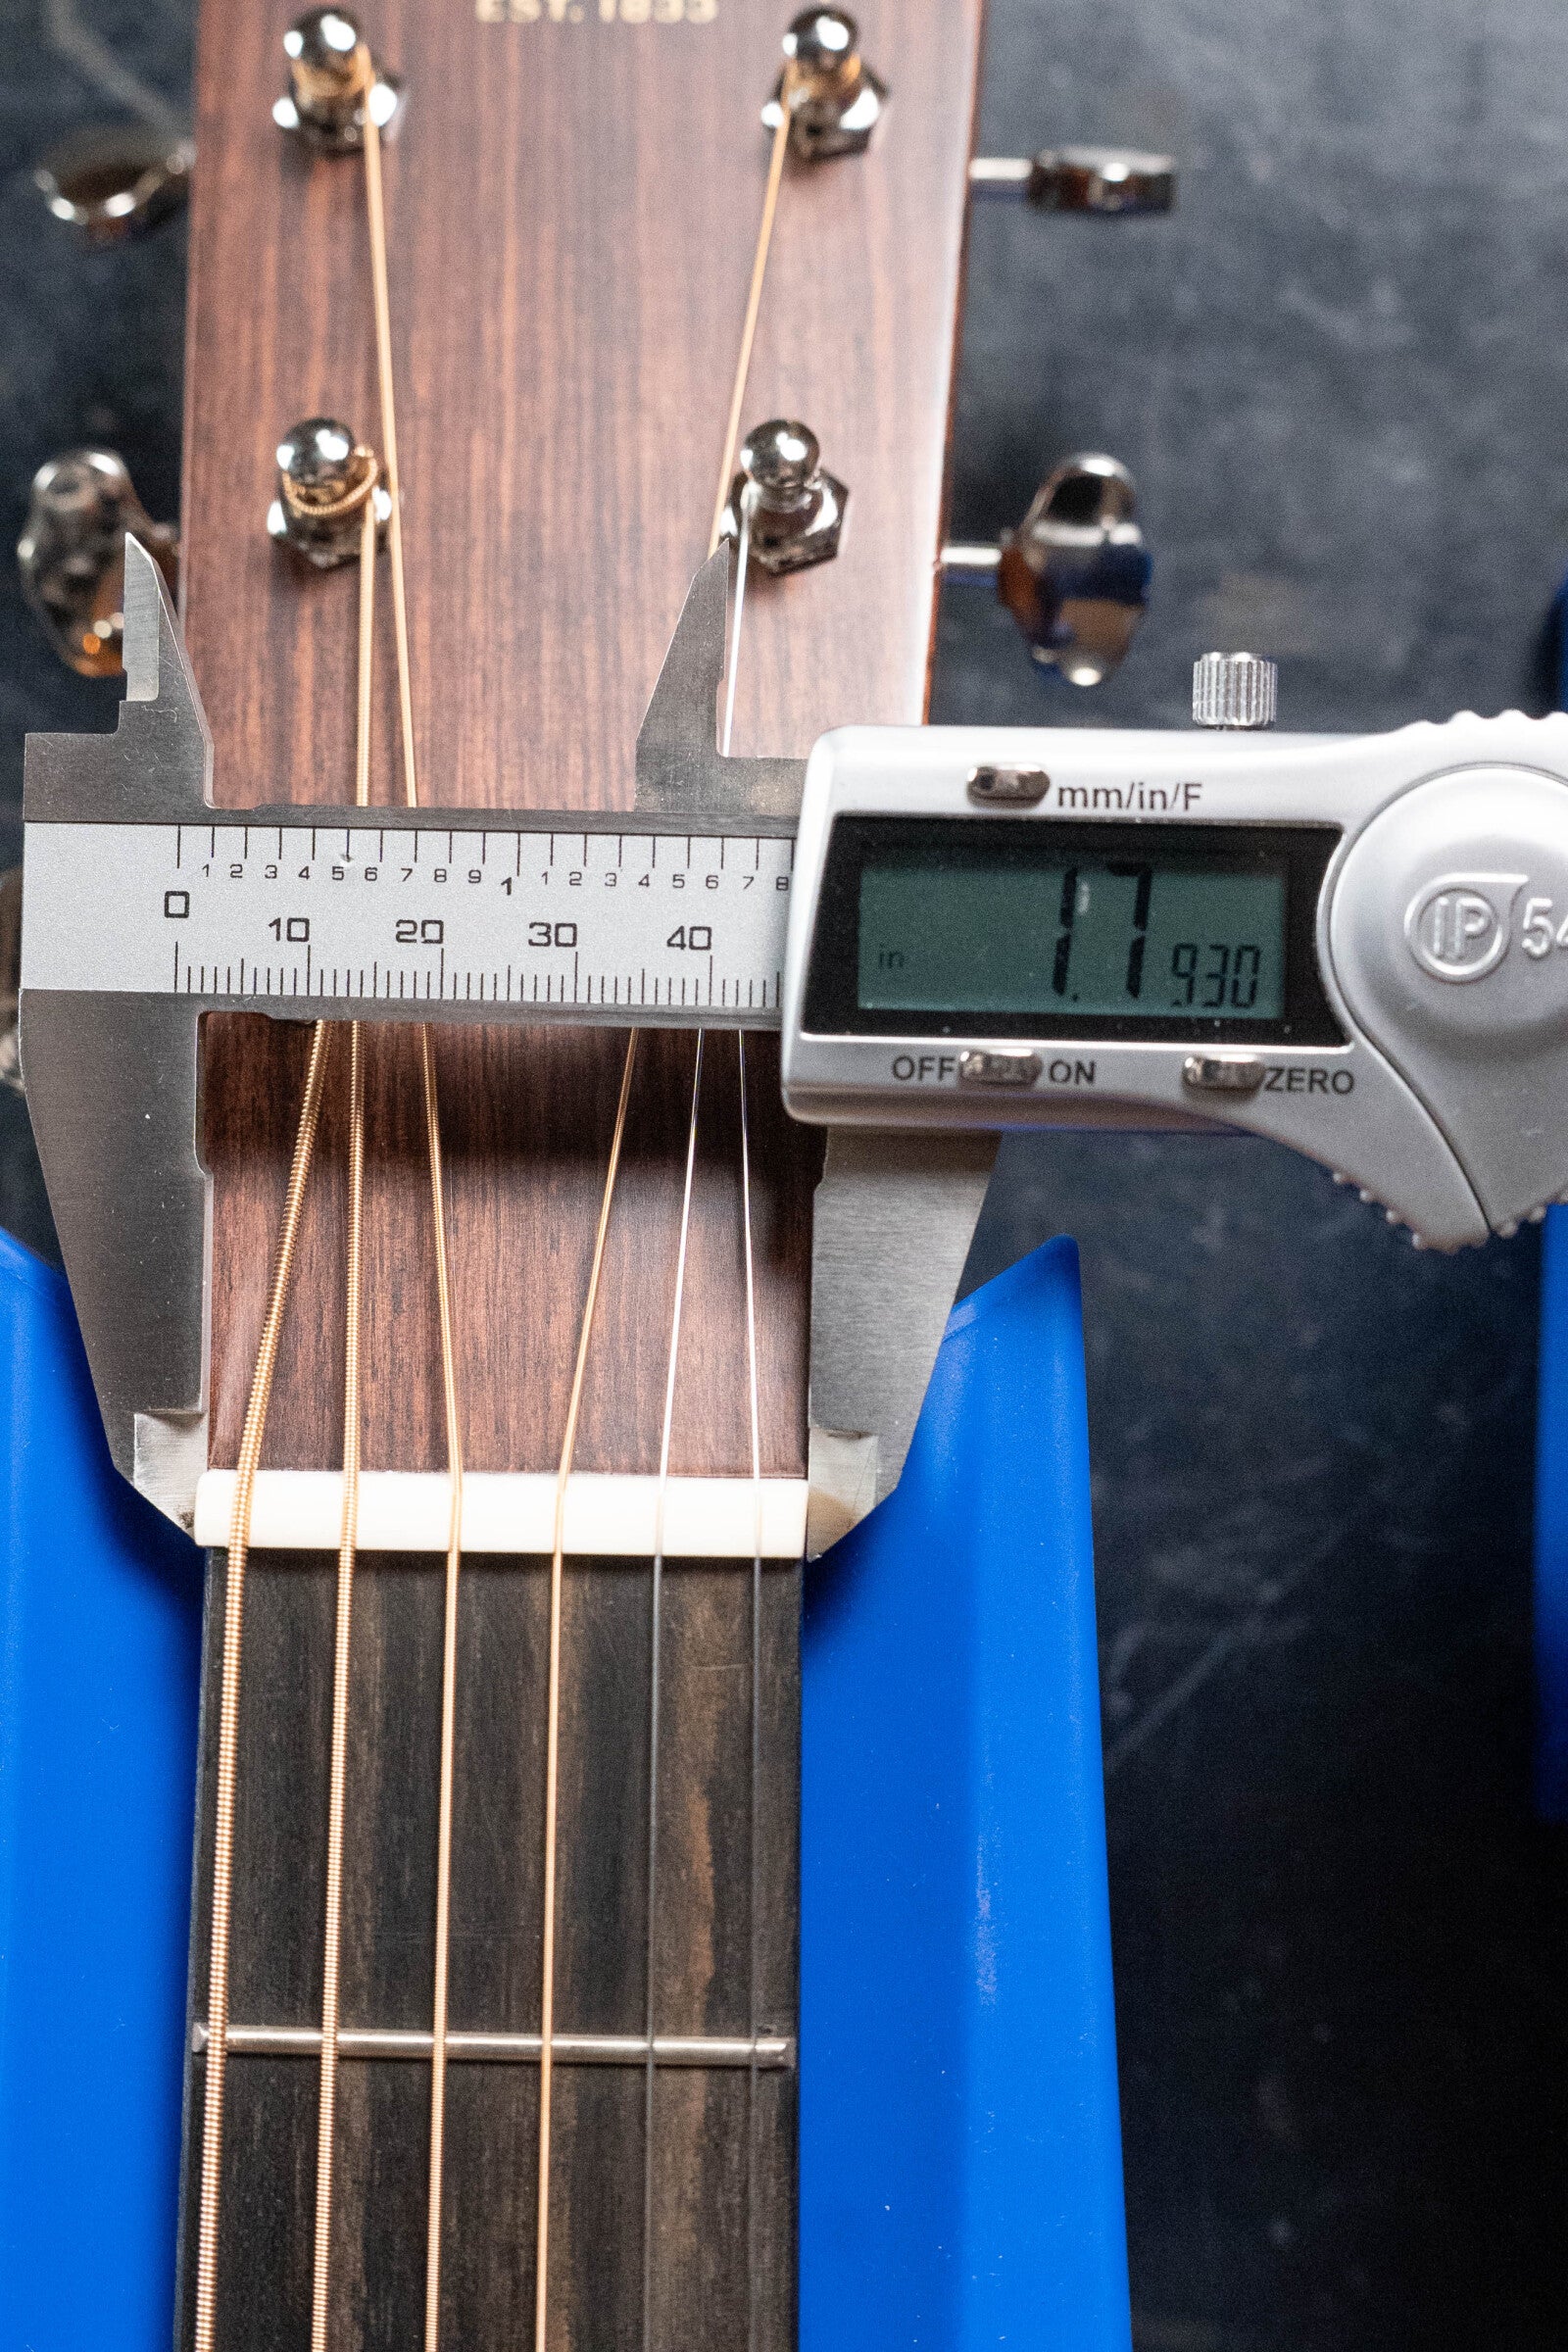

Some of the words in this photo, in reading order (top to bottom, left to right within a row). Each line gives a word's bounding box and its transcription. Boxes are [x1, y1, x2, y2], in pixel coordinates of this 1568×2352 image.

[1056, 782, 1202, 811] mm/in/F
[201, 863, 211, 878] 1
[229, 863, 244, 879] 2
[264, 864, 278, 880] 3
[298, 865, 311, 880] 4
[331, 866, 345, 881] 5
[364, 866, 378, 882] 6
[400, 867, 414, 883] 7
[433, 868, 448, 884] 8
[467, 869, 482, 884] 9
[500, 876, 513, 896] 1
[541, 871, 549, 886] 1
[568, 871, 583, 887] 2
[604, 872, 617, 887] 3
[638, 873, 651, 888] 4
[672, 873, 685, 889] 5
[705, 874, 719, 890] 6
[742, 875, 755, 890] 7
[775, 876, 790, 892] 8
[164, 890, 190, 919] 0
[269, 917, 311, 943] 10
[395, 919, 444, 945] 20
[527, 921, 578, 948] 30
[666, 925, 712, 951] 40
[891, 1054, 956, 1083] OFF
[1049, 1059, 1096, 1085] ON
[1264, 1067, 1355, 1096] ZERO
